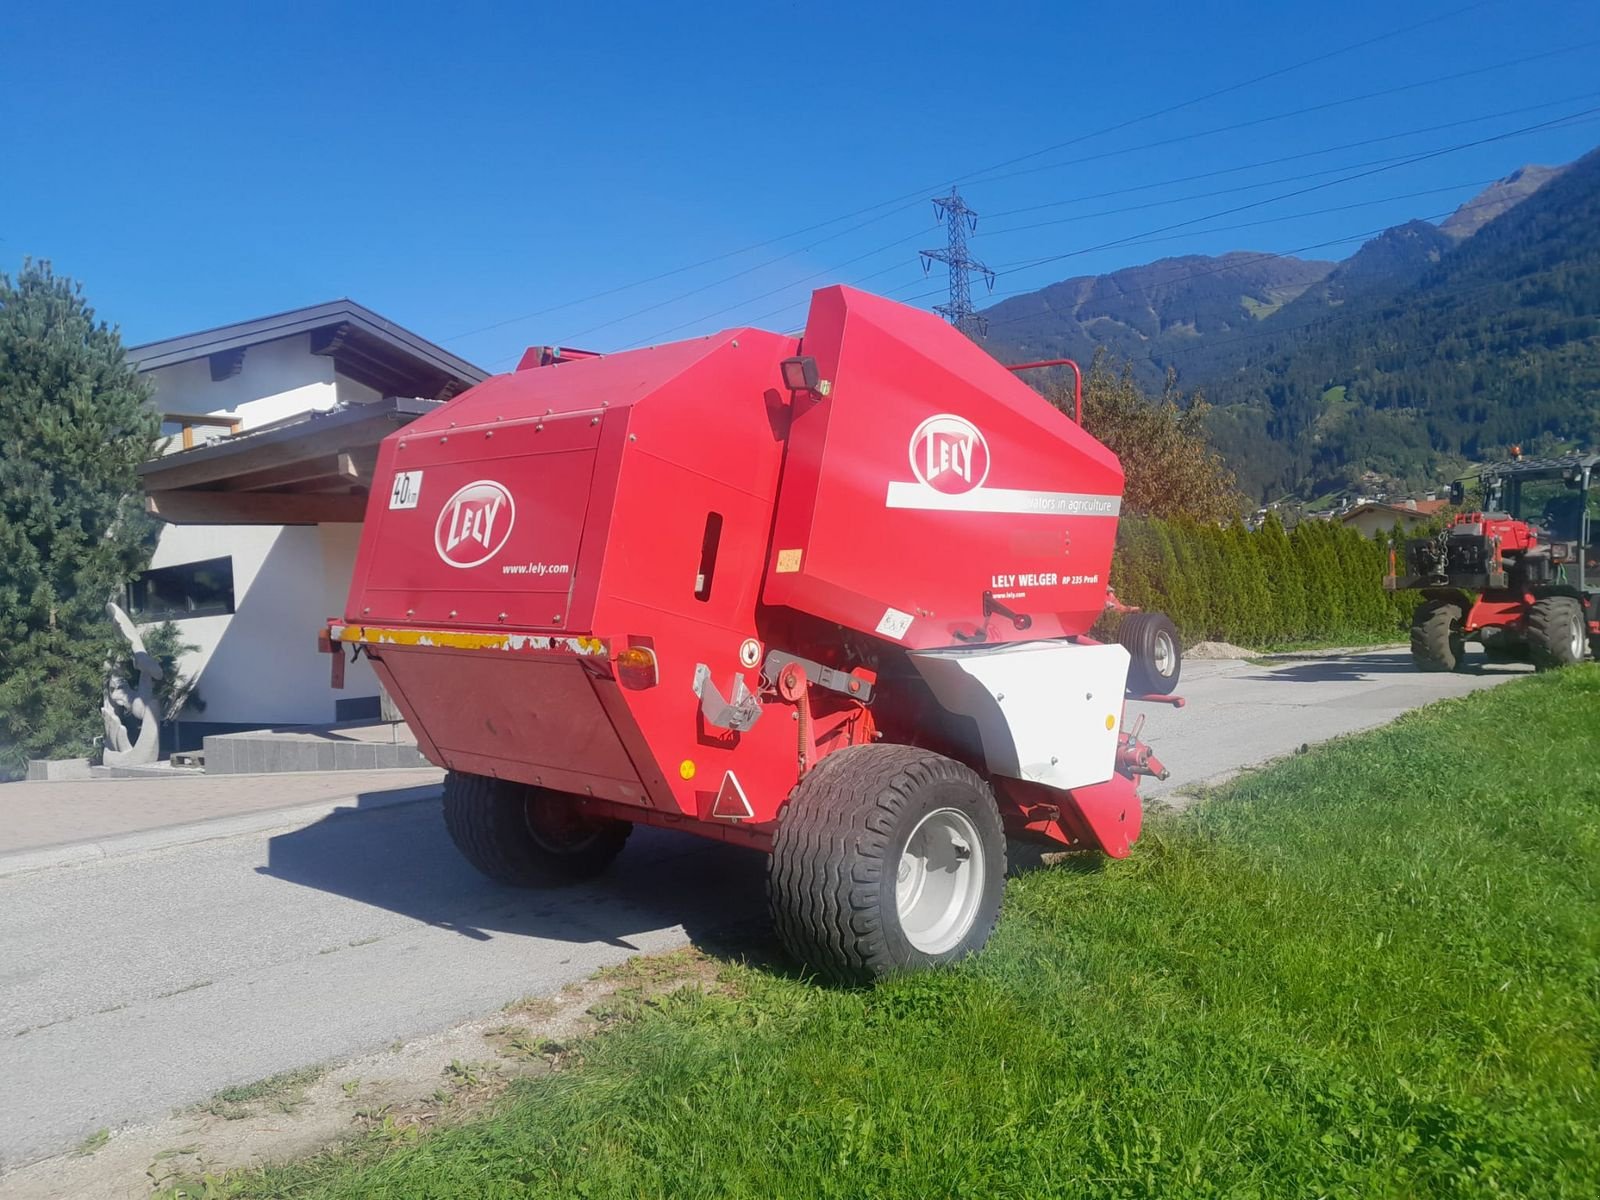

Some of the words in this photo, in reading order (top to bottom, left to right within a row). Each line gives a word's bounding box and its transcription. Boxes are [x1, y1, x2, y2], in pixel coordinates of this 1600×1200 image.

[926, 430, 974, 483] LELY
[394, 476, 410, 504] 40
[1057, 497, 1066, 510] in
[1068, 498, 1112, 513] agriculture
[446, 495, 501, 552] LELY
[502, 562, 569, 577] www.lely.com
[992, 574, 1016, 588] LELY
[1018, 573, 1058, 587] WELGER
[1062, 576, 1071, 585] RP
[1071, 575, 1083, 585] 235
[1083, 574, 1099, 585] Profi
[992, 591, 1026, 600] www.lely.com
